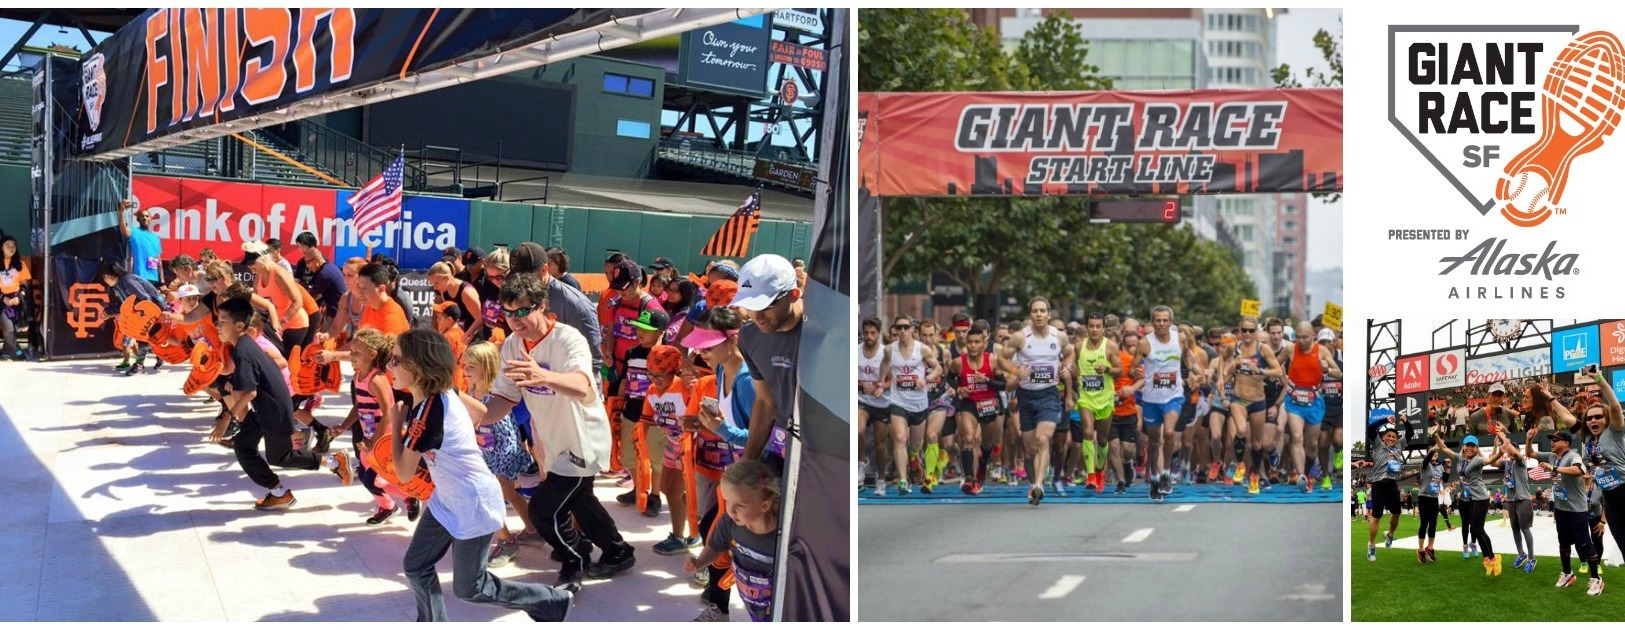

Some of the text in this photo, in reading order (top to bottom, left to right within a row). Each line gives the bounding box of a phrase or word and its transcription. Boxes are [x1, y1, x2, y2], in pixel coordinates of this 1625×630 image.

[773, 10, 818, 27] HARTFORD
[703, 31, 757, 58] Own your
[802, 48, 823, 61] FOUL
[146, 8, 356, 134] FINISH
[955, 101, 1288, 151] GIANT RACE
[769, 166, 799, 180] GARDEN
[1026, 154, 1217, 184] START LINE
[1163, 201, 1176, 220] 2
[239, 203, 285, 243] of
[291, 204, 456, 250] America
[400, 277, 427, 287] Quest
[1435, 374, 1458, 382] SAFEWAY
[1466, 364, 1551, 385] Coors LIGHT
[1403, 381, 1422, 390] Adobe
